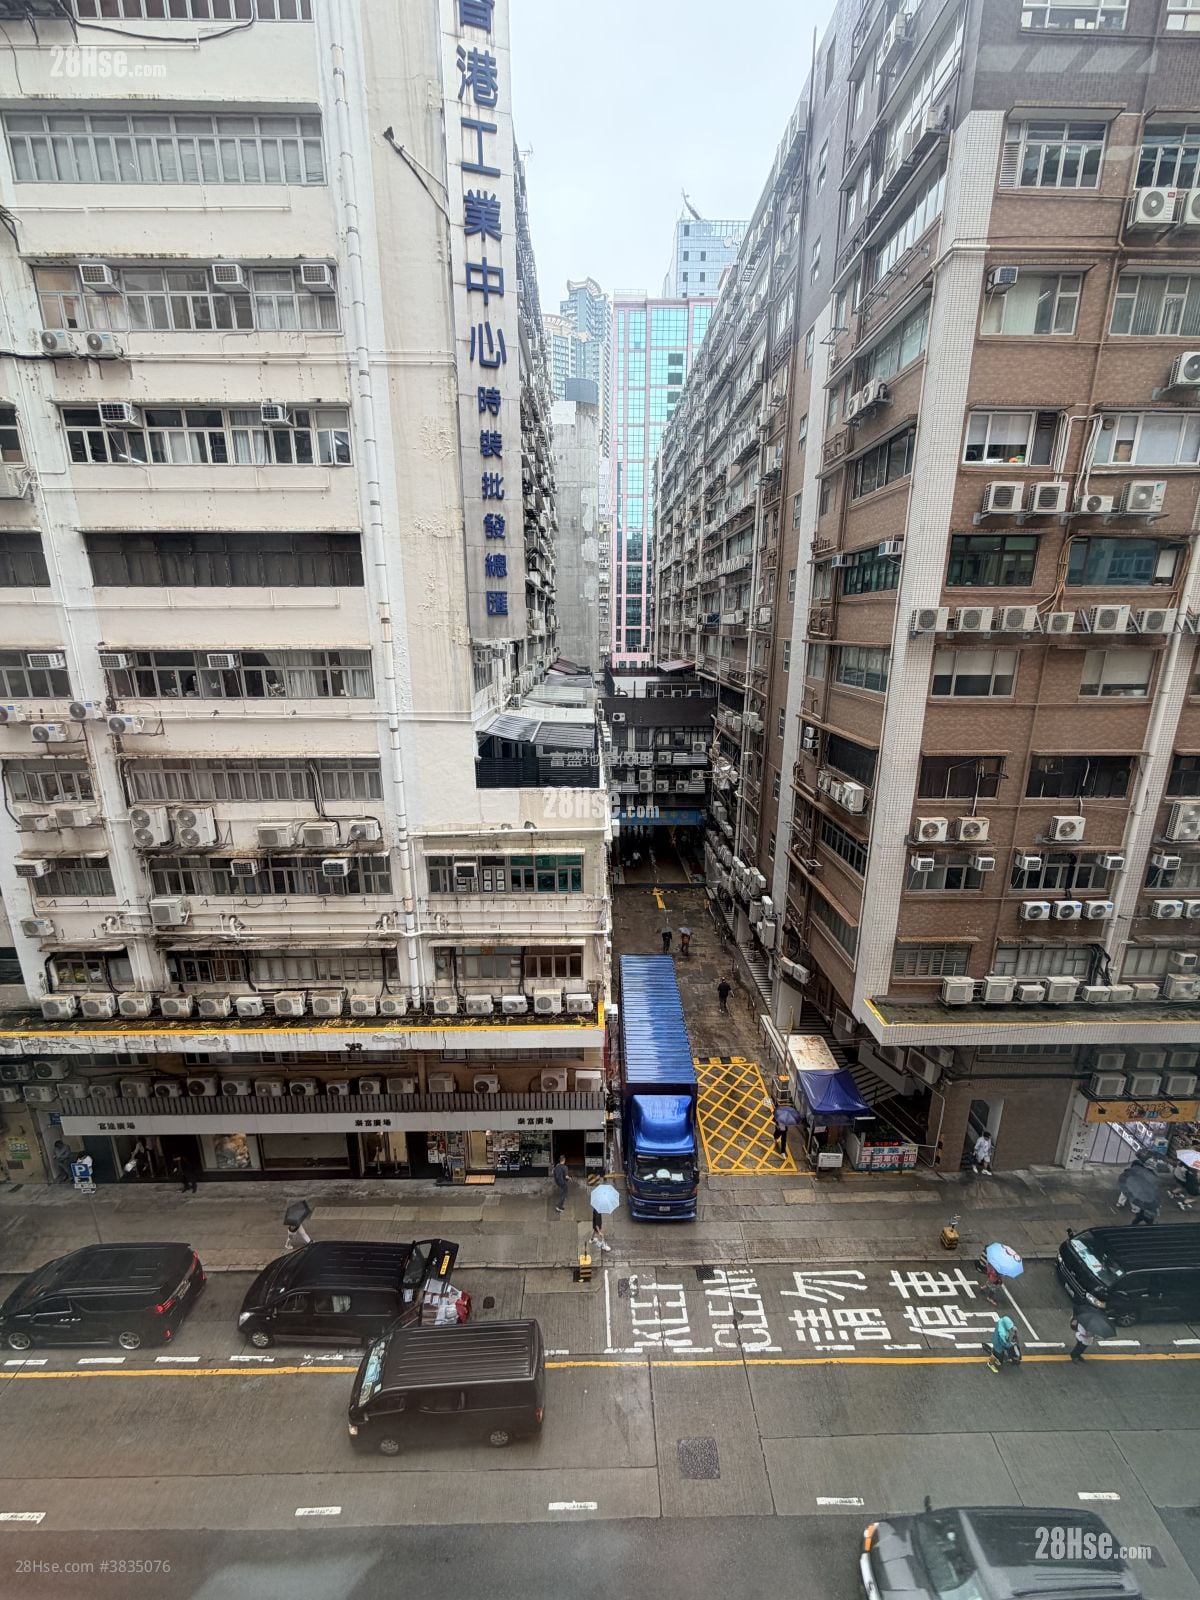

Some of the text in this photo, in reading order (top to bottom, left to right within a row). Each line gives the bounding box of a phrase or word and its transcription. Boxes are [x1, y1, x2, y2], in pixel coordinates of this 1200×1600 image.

[477, 386, 509, 617] 時裝批發總匯
[75, 1165, 86, 1176] P
[629, 1274, 693, 1347] KEEP
[703, 1269, 772, 1348] CLEAR
